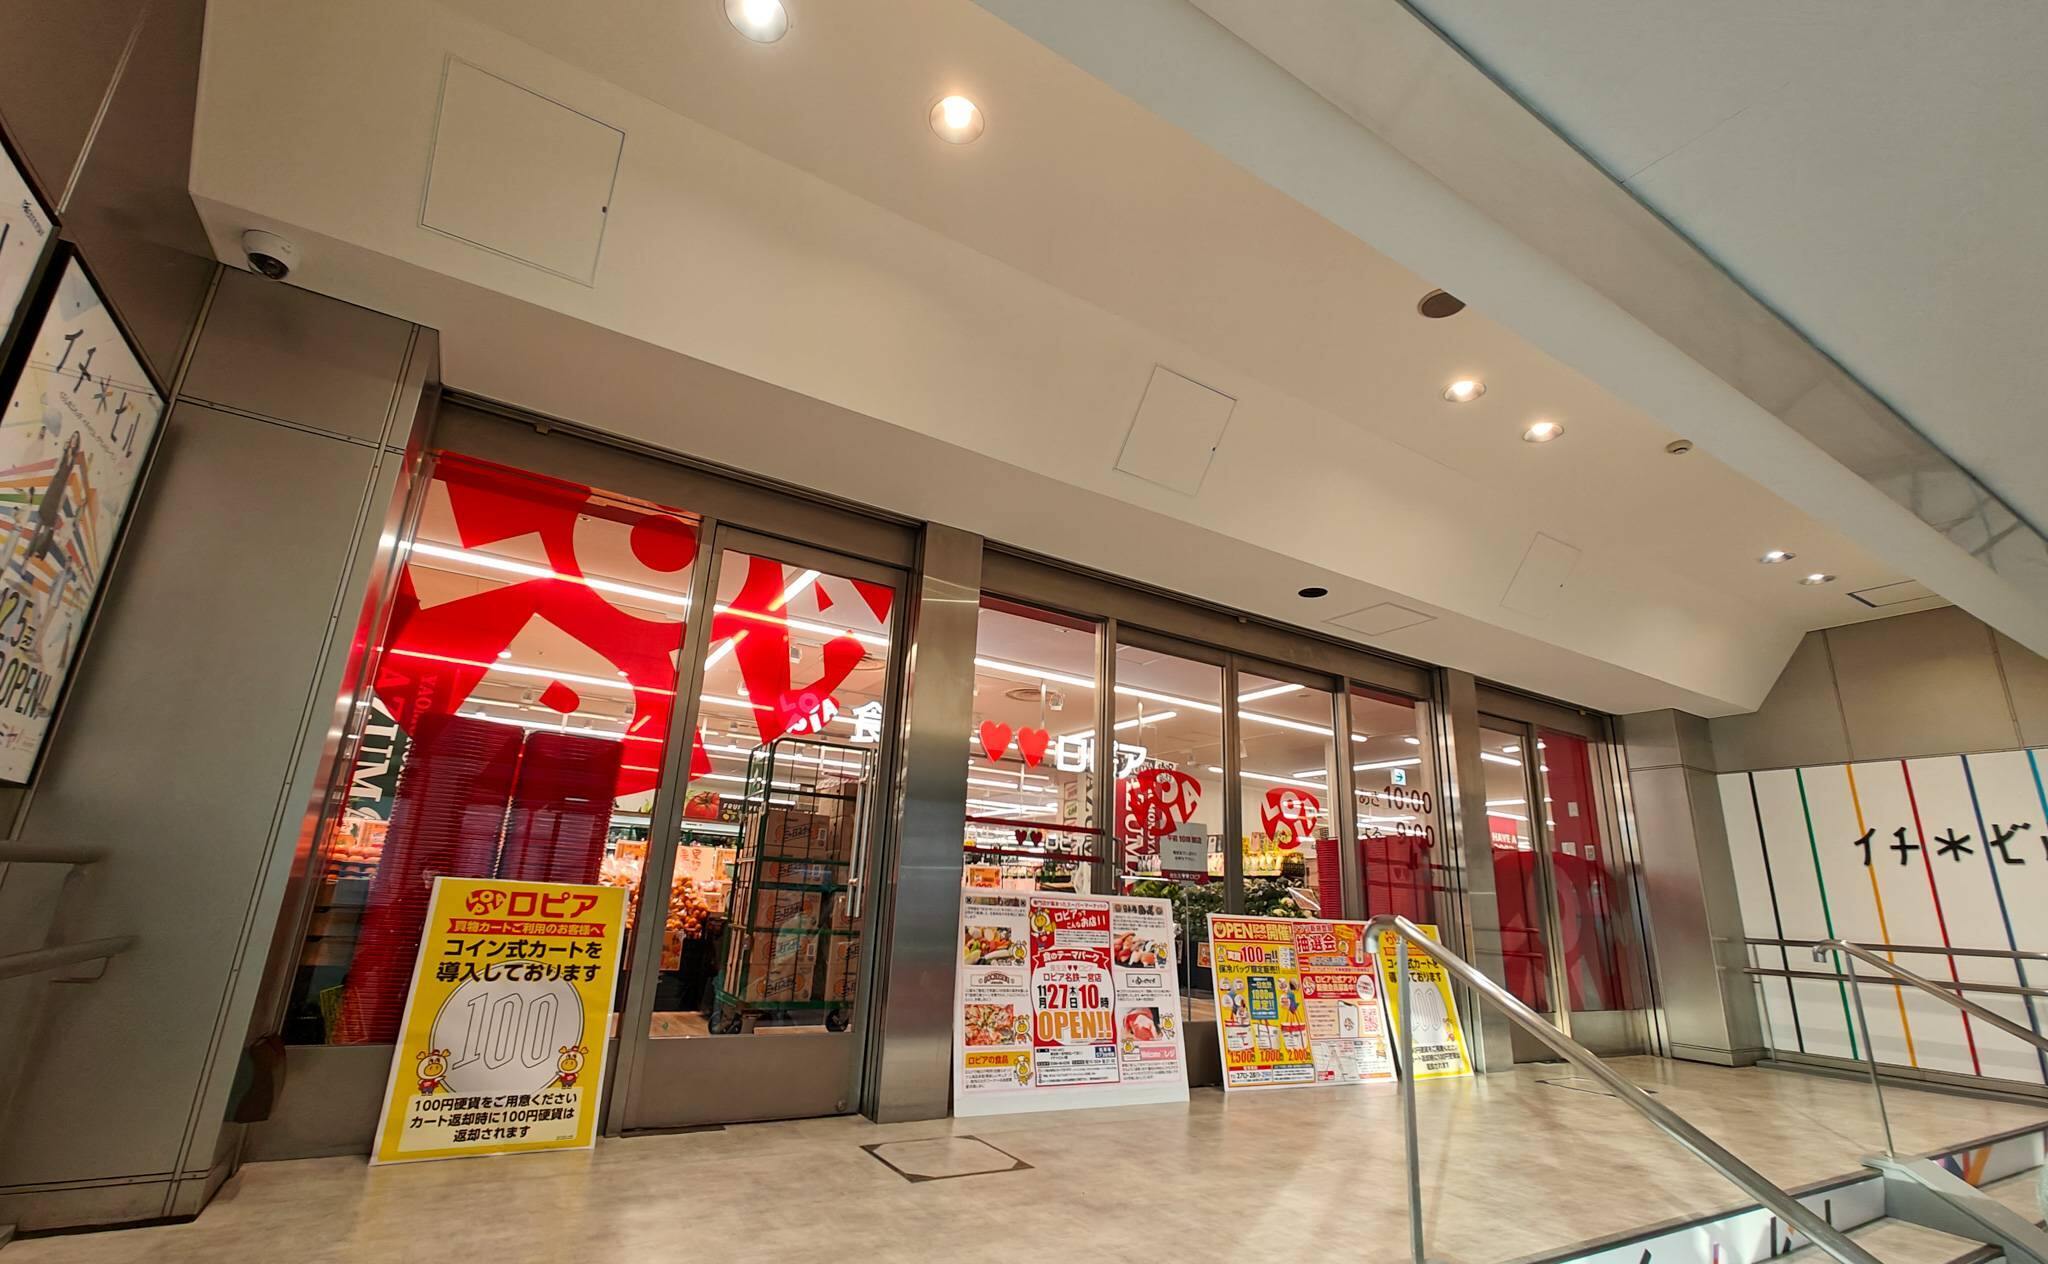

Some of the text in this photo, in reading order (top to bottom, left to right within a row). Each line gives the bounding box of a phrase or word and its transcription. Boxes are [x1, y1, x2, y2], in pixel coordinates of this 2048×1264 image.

[1384, 786, 1432, 814] 10:00
[1396, 822, 1434, 848] 9:00
[507, 891, 598, 918] ロピア
[453, 920, 601, 936] 買物カートご利用のお客様へ
[444, 939, 602, 959] コイン式カートを
[1297, 934, 1337, 952] 抽選会
[436, 961, 602, 982] 導入しております
[452, 992, 559, 1070] 100
[1039, 1011, 1112, 1040] OPEN!!
[414, 1092, 578, 1112] 100円硬貨をご用意ください
[409, 1107, 575, 1129] カート返却時に100円硬貨は
[452, 1125, 531, 1143] 返却されます
